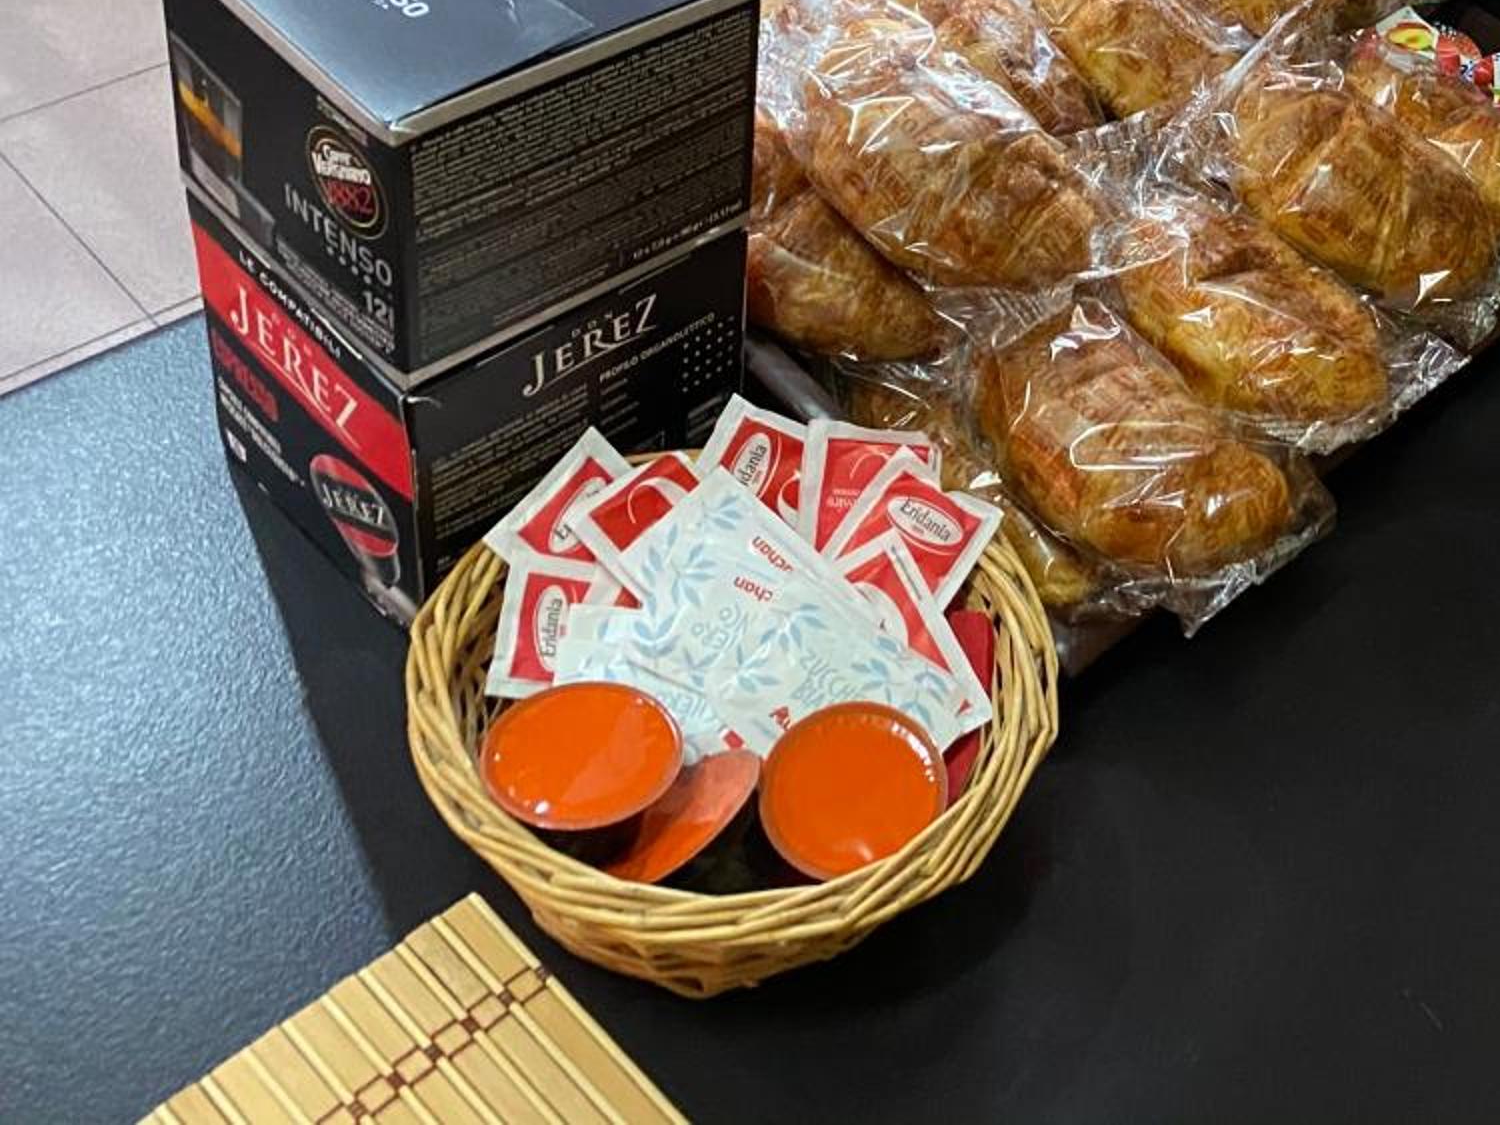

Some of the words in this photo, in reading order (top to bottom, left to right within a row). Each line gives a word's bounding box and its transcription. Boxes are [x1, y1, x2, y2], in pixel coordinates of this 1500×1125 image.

[284, 183, 393, 287] INTENSO
[230, 285, 361, 443] JEREZ
[522, 293, 657, 397] JEREZ
[900, 497, 951, 542] Eridania
[540, 597, 563, 657] Eridania
